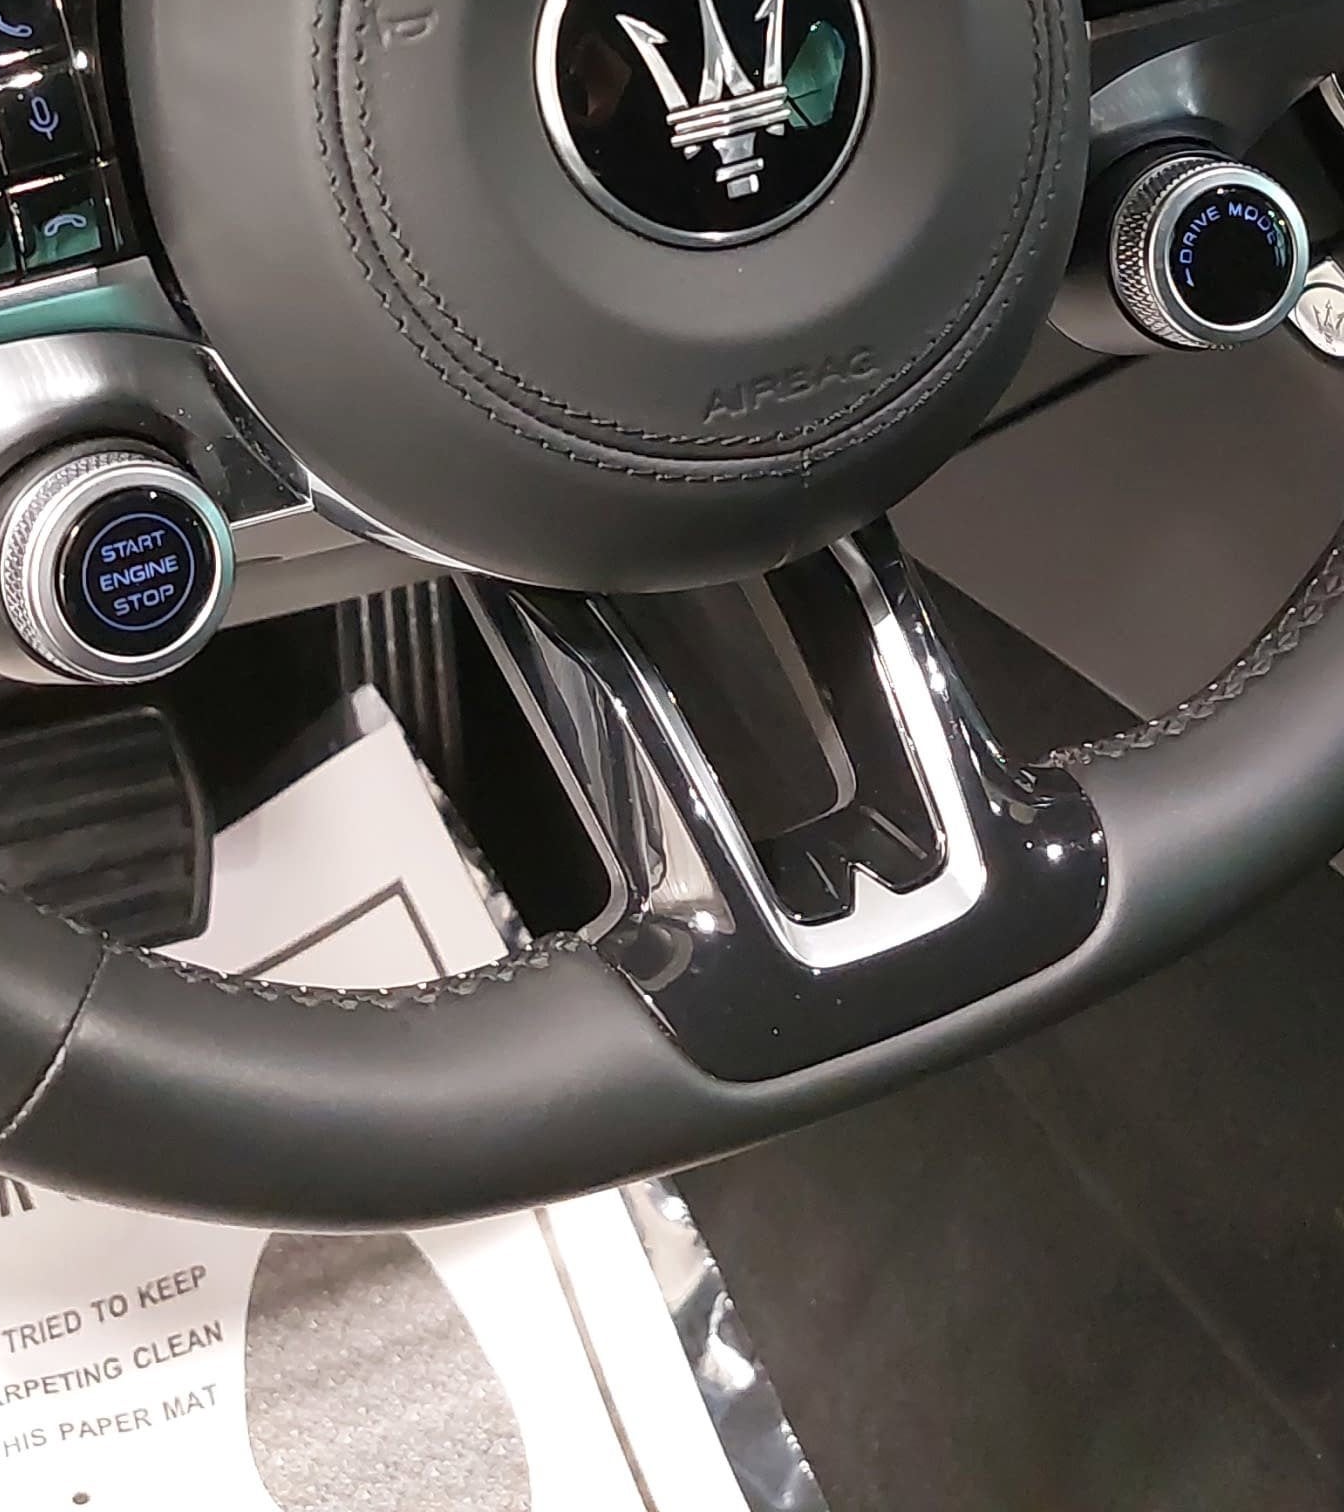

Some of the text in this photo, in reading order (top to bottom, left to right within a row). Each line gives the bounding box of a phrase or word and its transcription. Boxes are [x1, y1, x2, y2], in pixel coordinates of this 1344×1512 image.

[1178, 201, 1278, 265] DRIVE MODE
[704, 348, 881, 425] AIRBAG
[101, 529, 166, 563] START
[99, 554, 179, 592] ENGINE
[113, 584, 175, 617] STOP
[1, 1309, 82, 1354] TRIED
[90, 1293, 128, 1324] TO
[137, 1264, 207, 1309] KEEP
[133, 1320, 224, 1369] CLEAN
[59, 1408, 153, 1441] PAPER
[162, 1383, 218, 1421] MAT
